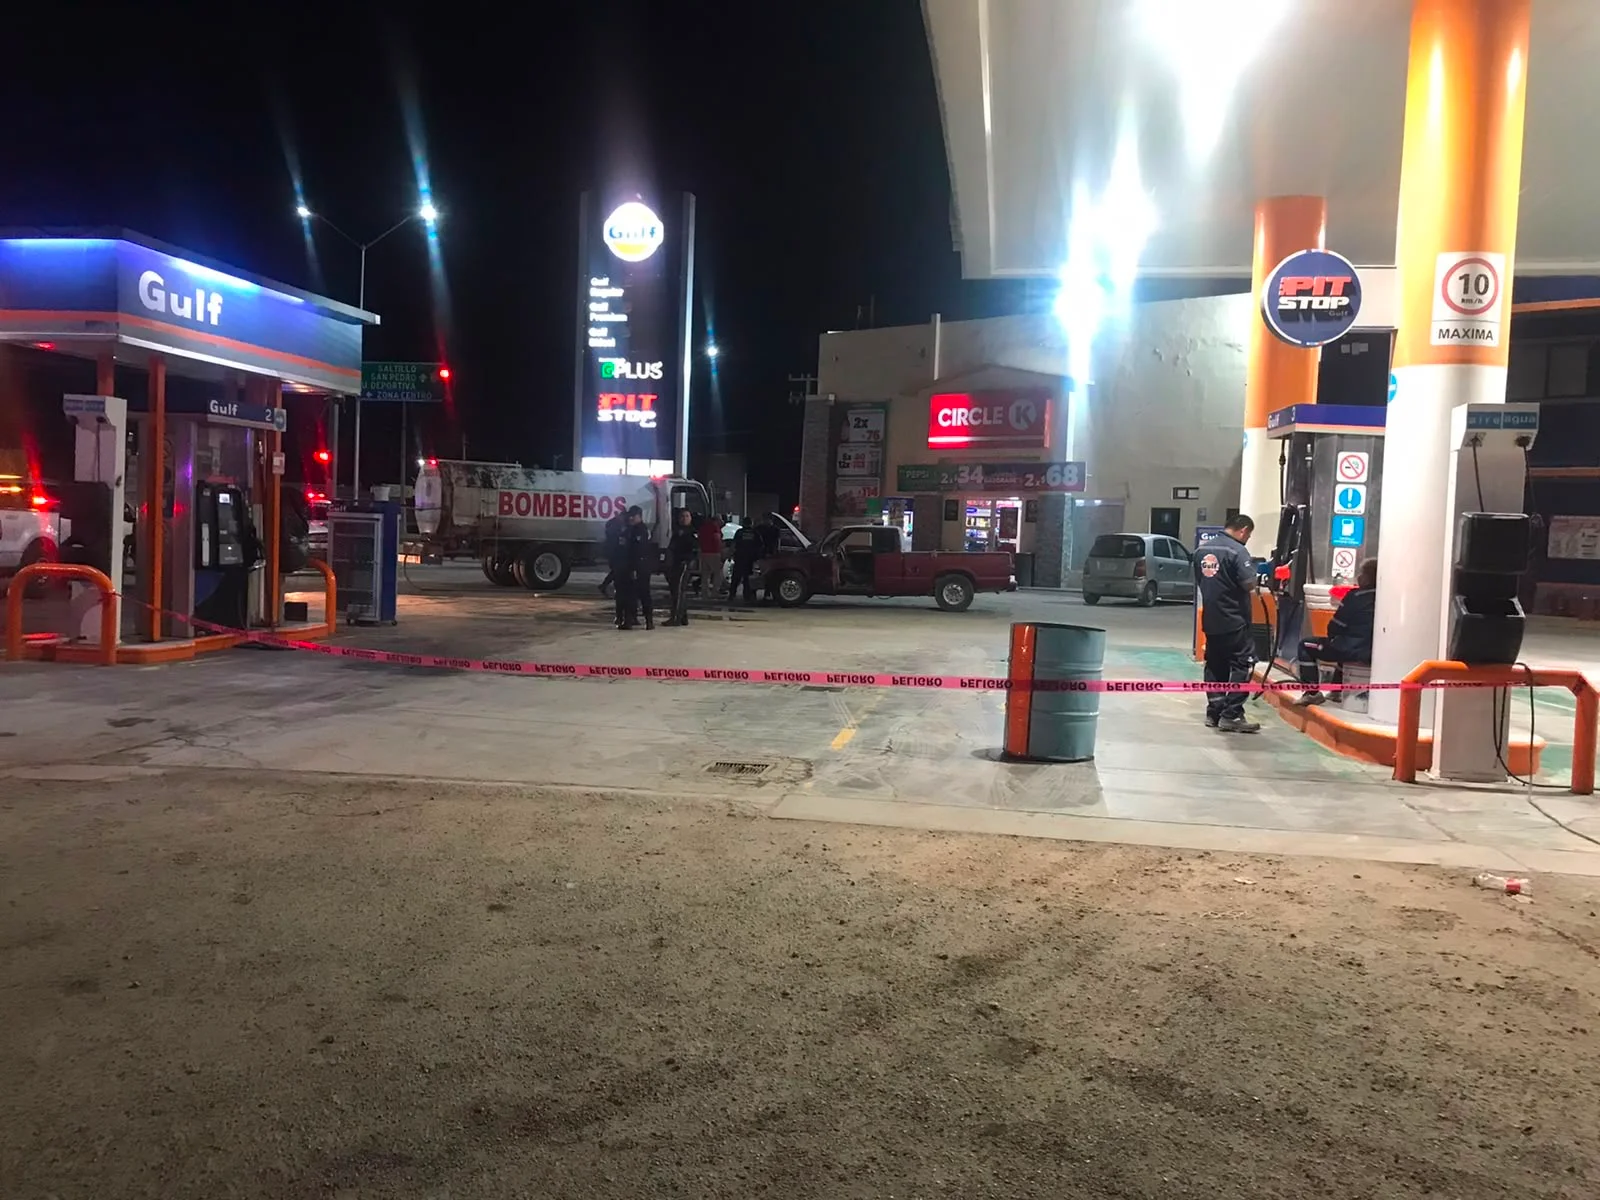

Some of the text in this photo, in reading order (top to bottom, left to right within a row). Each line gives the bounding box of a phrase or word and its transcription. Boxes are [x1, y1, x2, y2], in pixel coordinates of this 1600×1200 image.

[608, 225, 657, 239] Gulf
[1279, 276, 1352, 296] PIT
[1458, 273, 1490, 296] 10
[139, 270, 223, 326] Gulf
[1278, 296, 1350, 310] STOP
[1438, 328, 1494, 341] MAXIMA
[378, 365, 417, 373] SALTILLO
[371, 373, 417, 381] SAN PEDRO
[370, 382, 417, 390] DEPORTIVA
[376, 391, 433, 400] ZONA CENTRO
[598, 393, 658, 411] PIT
[210, 399, 272, 421] Gulf 2
[597, 409, 657, 423] STOP
[937, 406, 1004, 427] CIRCLE
[853, 417, 869, 429] 2x
[1468, 414, 1536, 425] aire agua
[499, 490, 627, 519] BOMBEROS
[1202, 561, 1217, 569] Gulf
